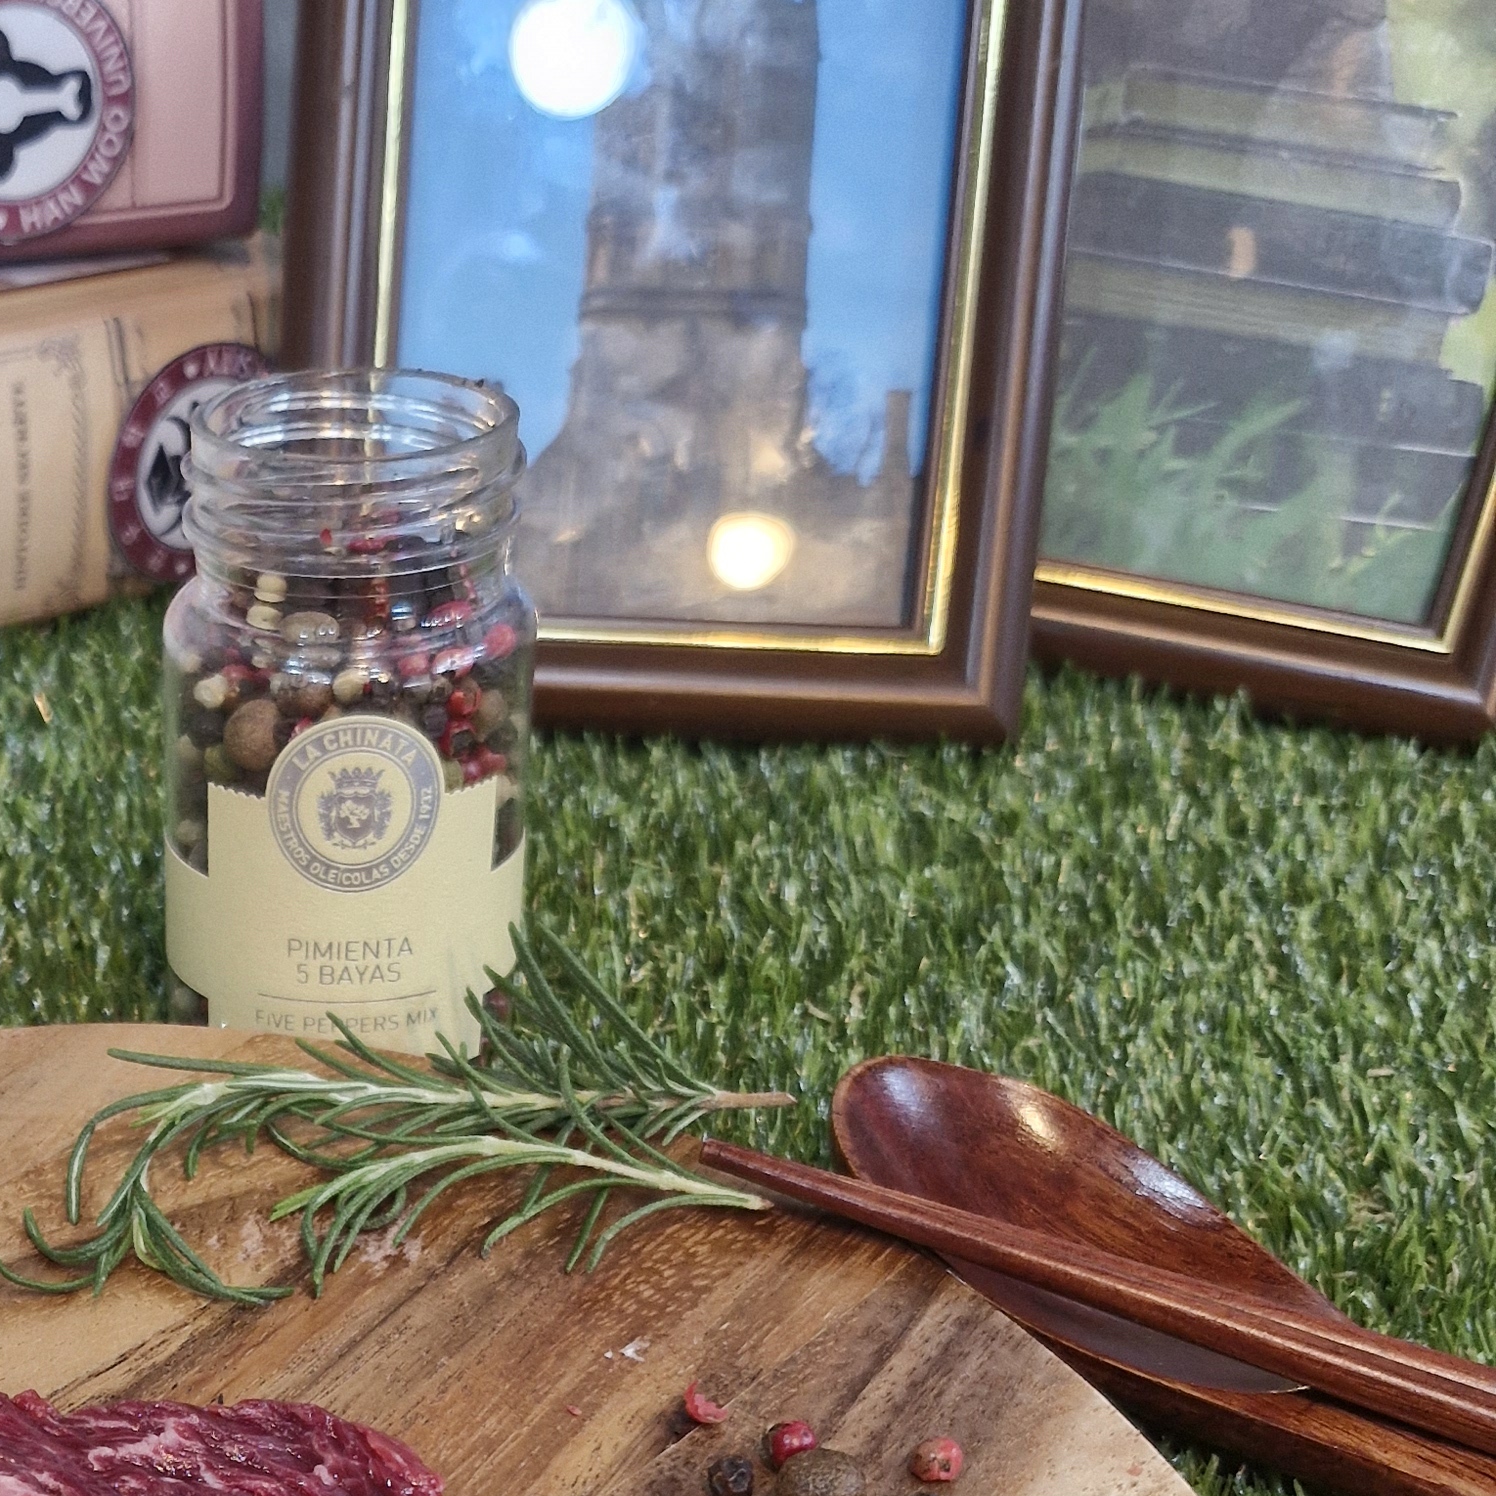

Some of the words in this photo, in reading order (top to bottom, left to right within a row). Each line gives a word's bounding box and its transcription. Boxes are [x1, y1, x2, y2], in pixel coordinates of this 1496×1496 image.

[82, 105, 129, 185] WOO
[292, 745, 322, 770] LA
[323, 729, 416, 766] CHINATA
[278, 790, 308, 865] MAESTROS
[391, 825, 426, 868] DESDE
[287, 937, 413, 961] PIMIENTA
[296, 964, 309, 984] 5
[319, 963, 402, 985] BAYAS
[255, 1009, 296, 1031] FIVE
[405, 1007, 438, 1027] MIX
